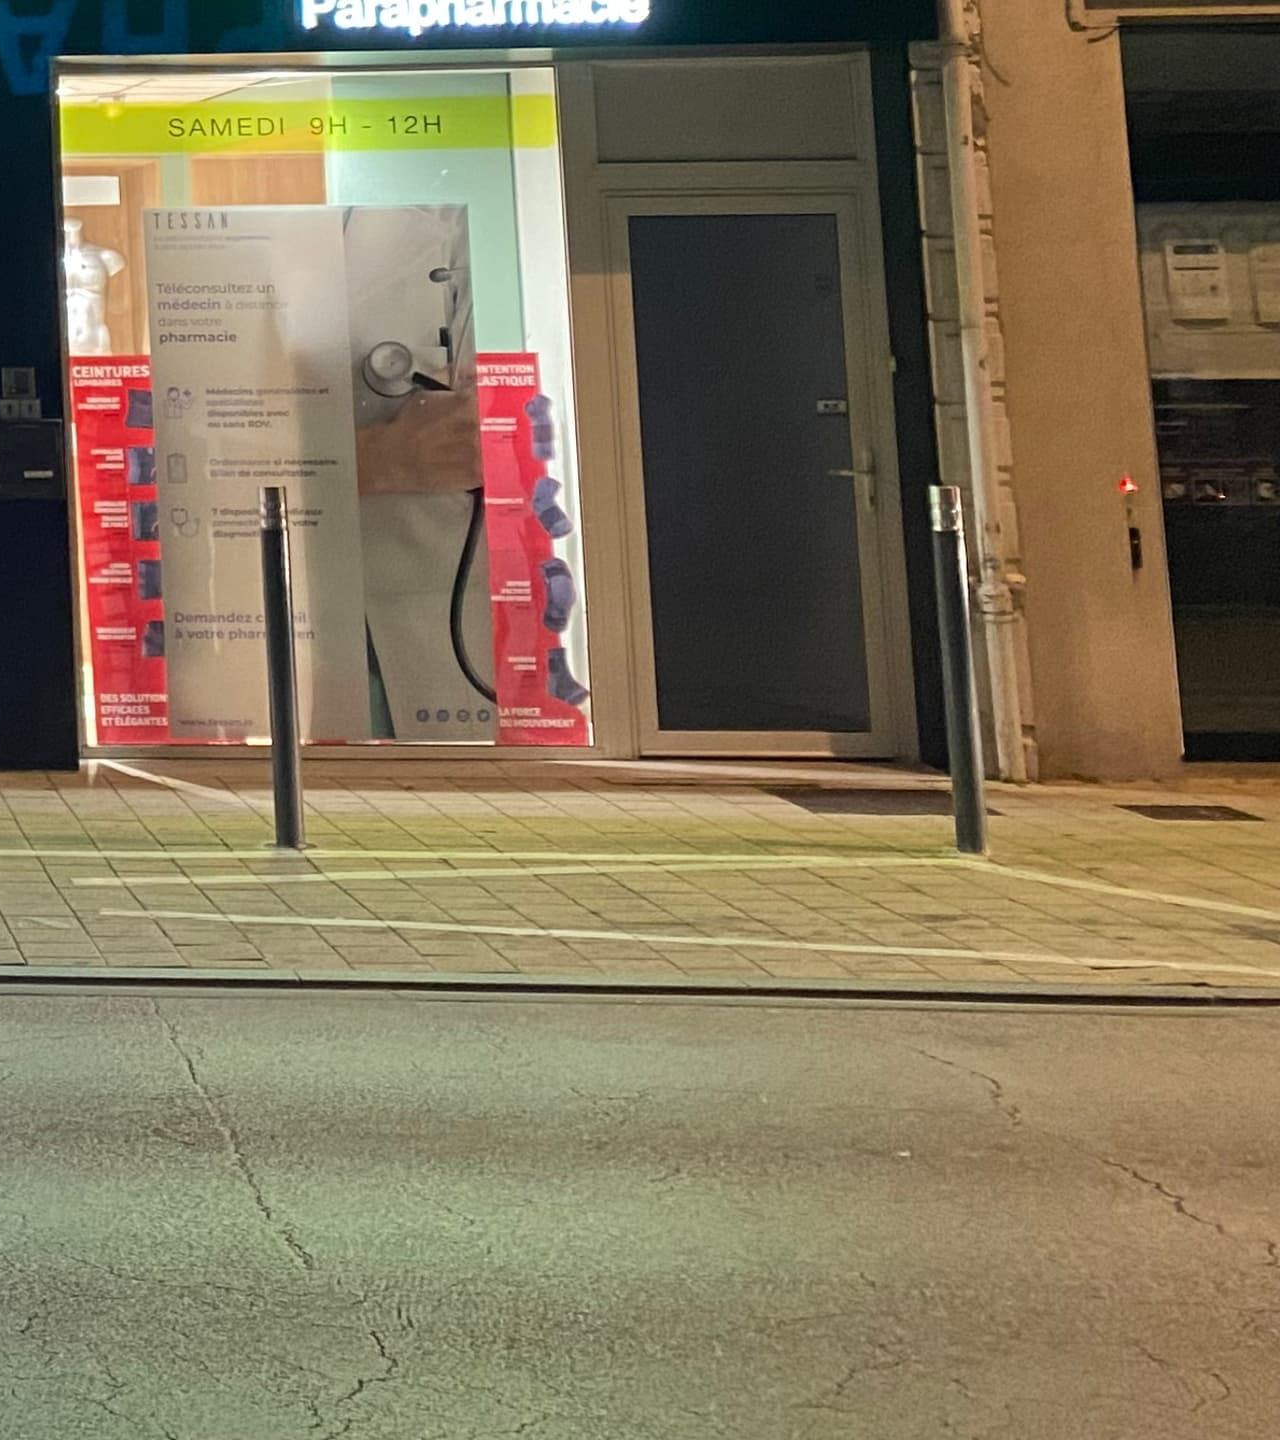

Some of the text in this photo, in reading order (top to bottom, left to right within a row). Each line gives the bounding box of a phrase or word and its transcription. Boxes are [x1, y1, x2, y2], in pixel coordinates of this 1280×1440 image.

[168, 116, 285, 138] SAMEDI
[309, 115, 347, 136] 9H
[389, 114, 443, 135] 12H
[153, 213, 228, 230] TESSAN
[155, 282, 276, 295] Téléconsultez un
[157, 298, 221, 311] médecin
[158, 317, 223, 327] dans votre
[159, 330, 237, 345] pharmacie
[72, 364, 151, 378] CEINTURES
[174, 611, 253, 623] Demandez
[186, 629, 225, 640] votre
